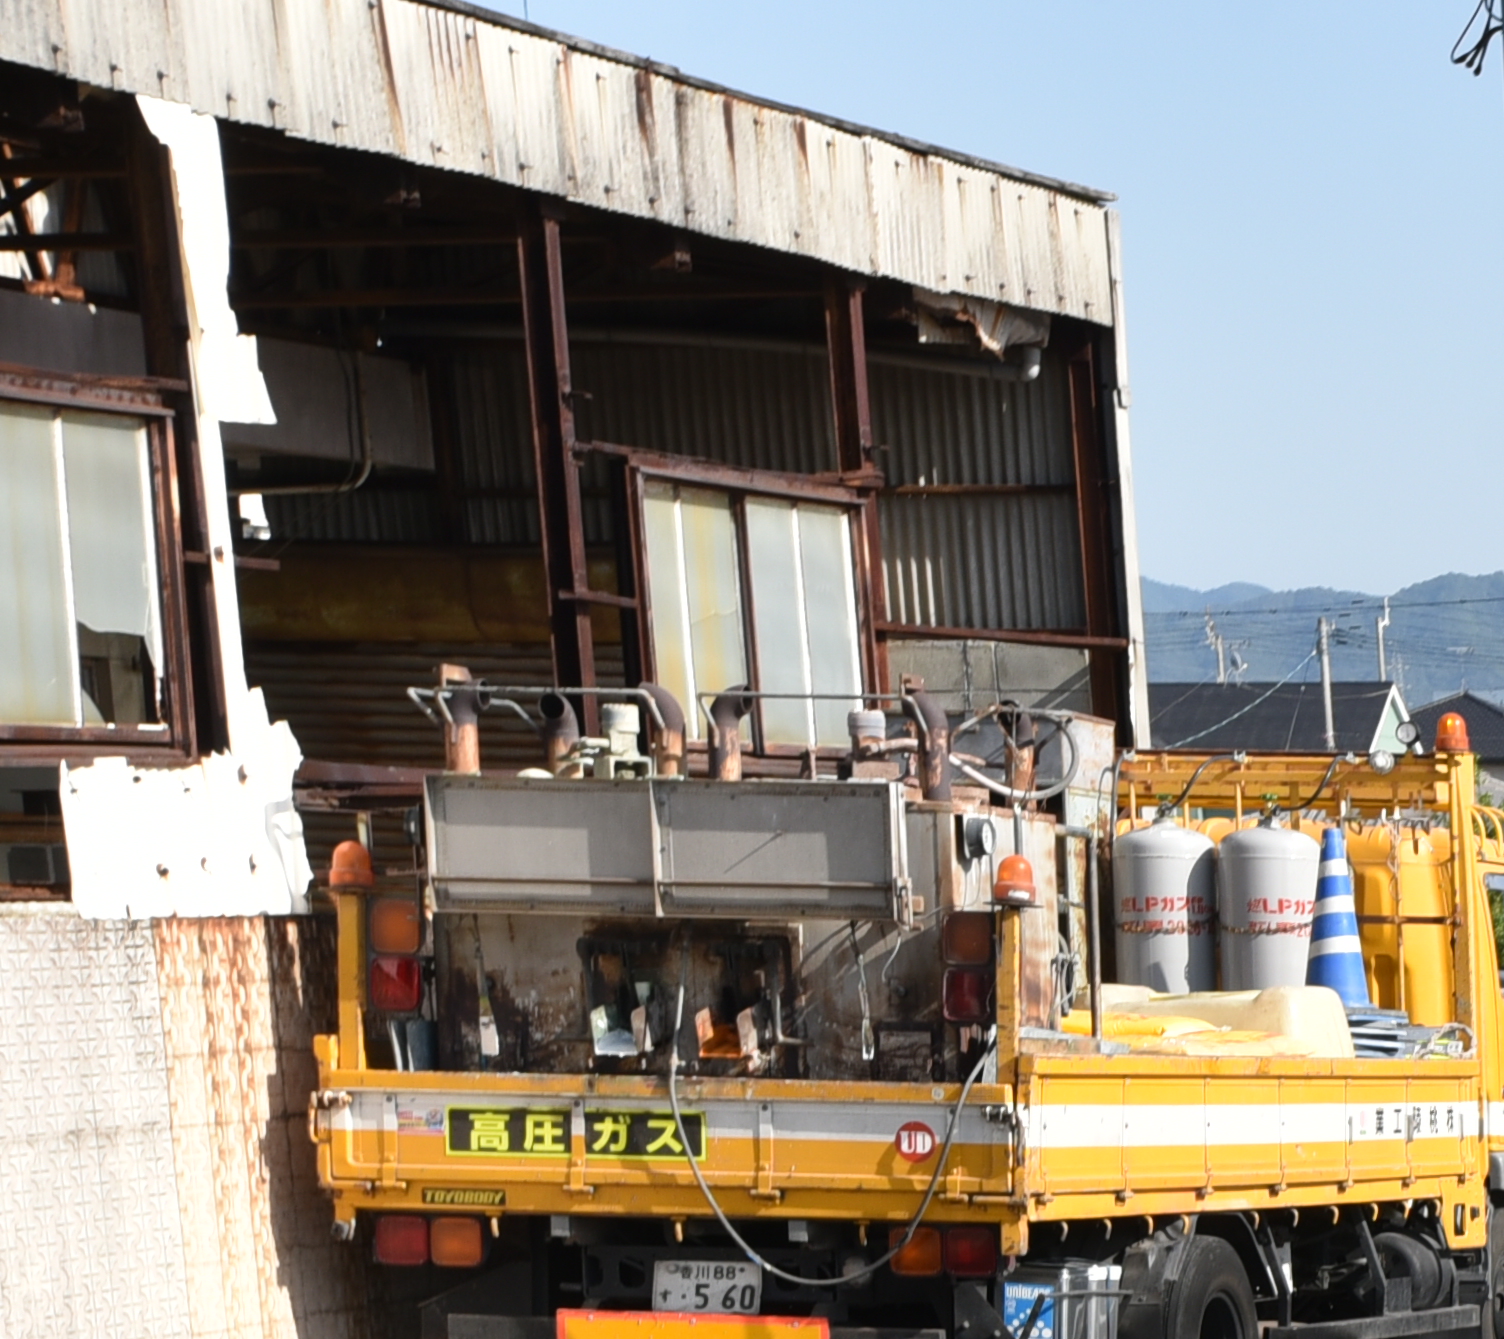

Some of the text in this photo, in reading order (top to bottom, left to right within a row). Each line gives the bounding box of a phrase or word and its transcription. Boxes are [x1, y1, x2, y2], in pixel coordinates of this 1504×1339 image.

[469, 1112, 684, 1154] 高圧ガス
[899, 1131, 932, 1154] UD
[424, 1189, 504, 1205] TOYOBODY
